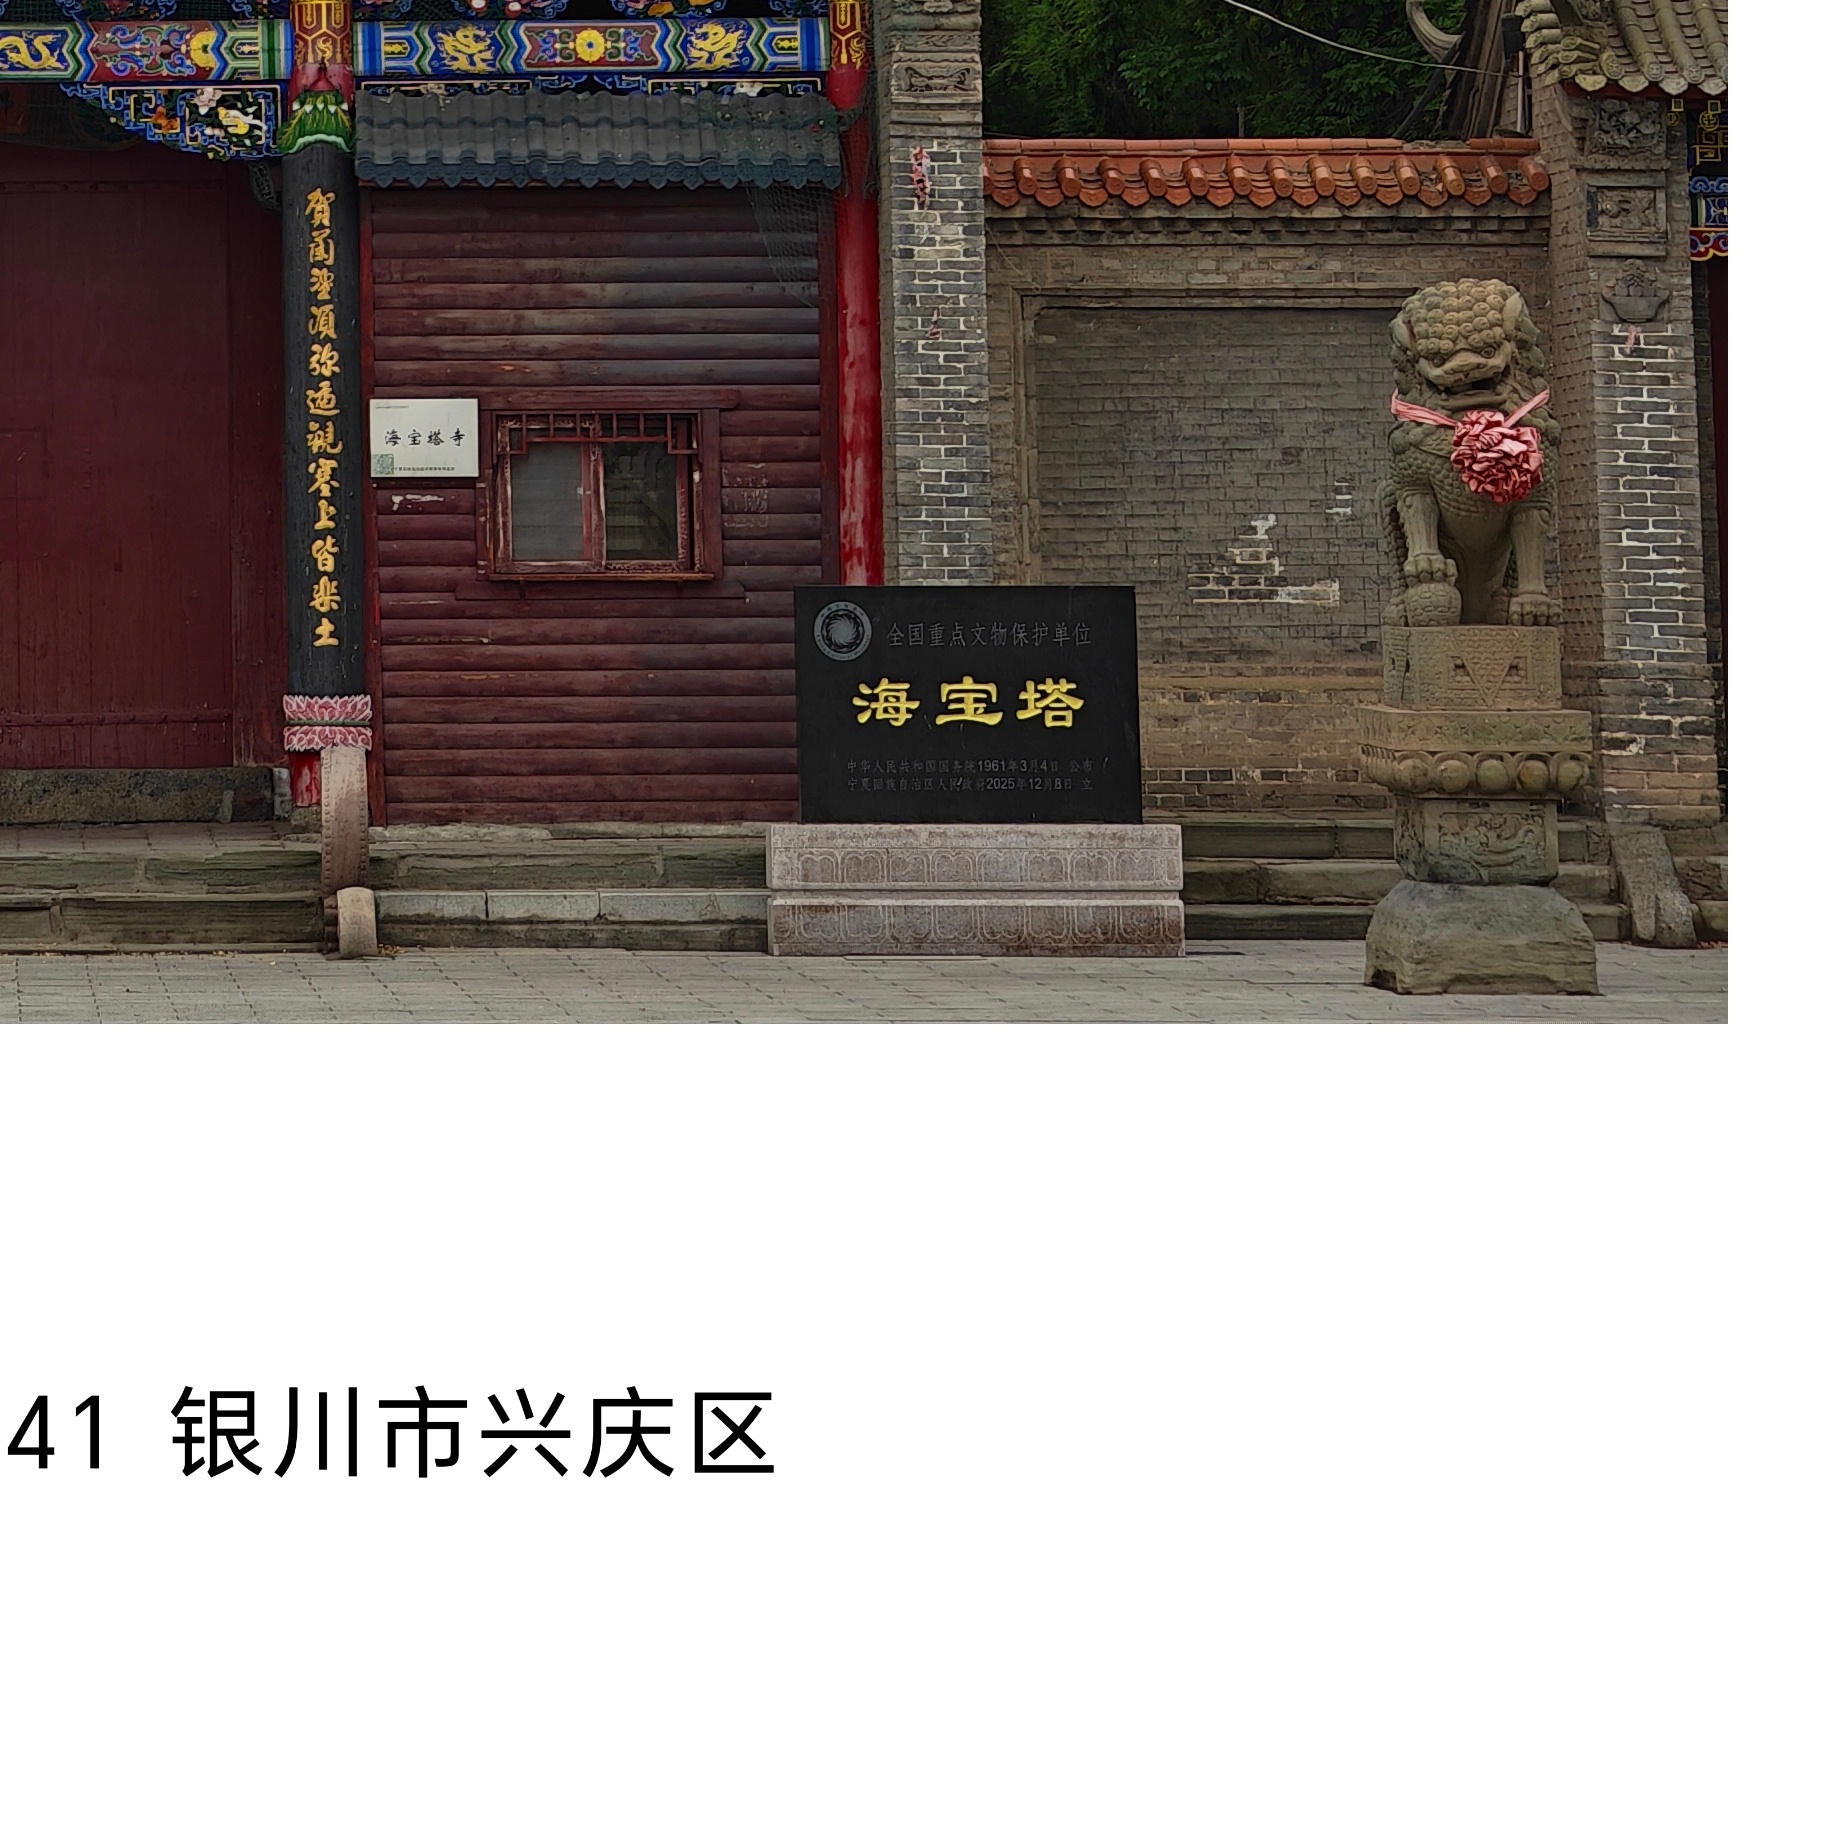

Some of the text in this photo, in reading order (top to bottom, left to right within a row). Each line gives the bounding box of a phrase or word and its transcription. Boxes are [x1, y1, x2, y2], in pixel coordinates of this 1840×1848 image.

[385, 428, 465, 446] 海宝塔寺
[886, 621, 1092, 647] 全国重点文物保护单位
[852, 676, 1085, 728] 海宝塔
